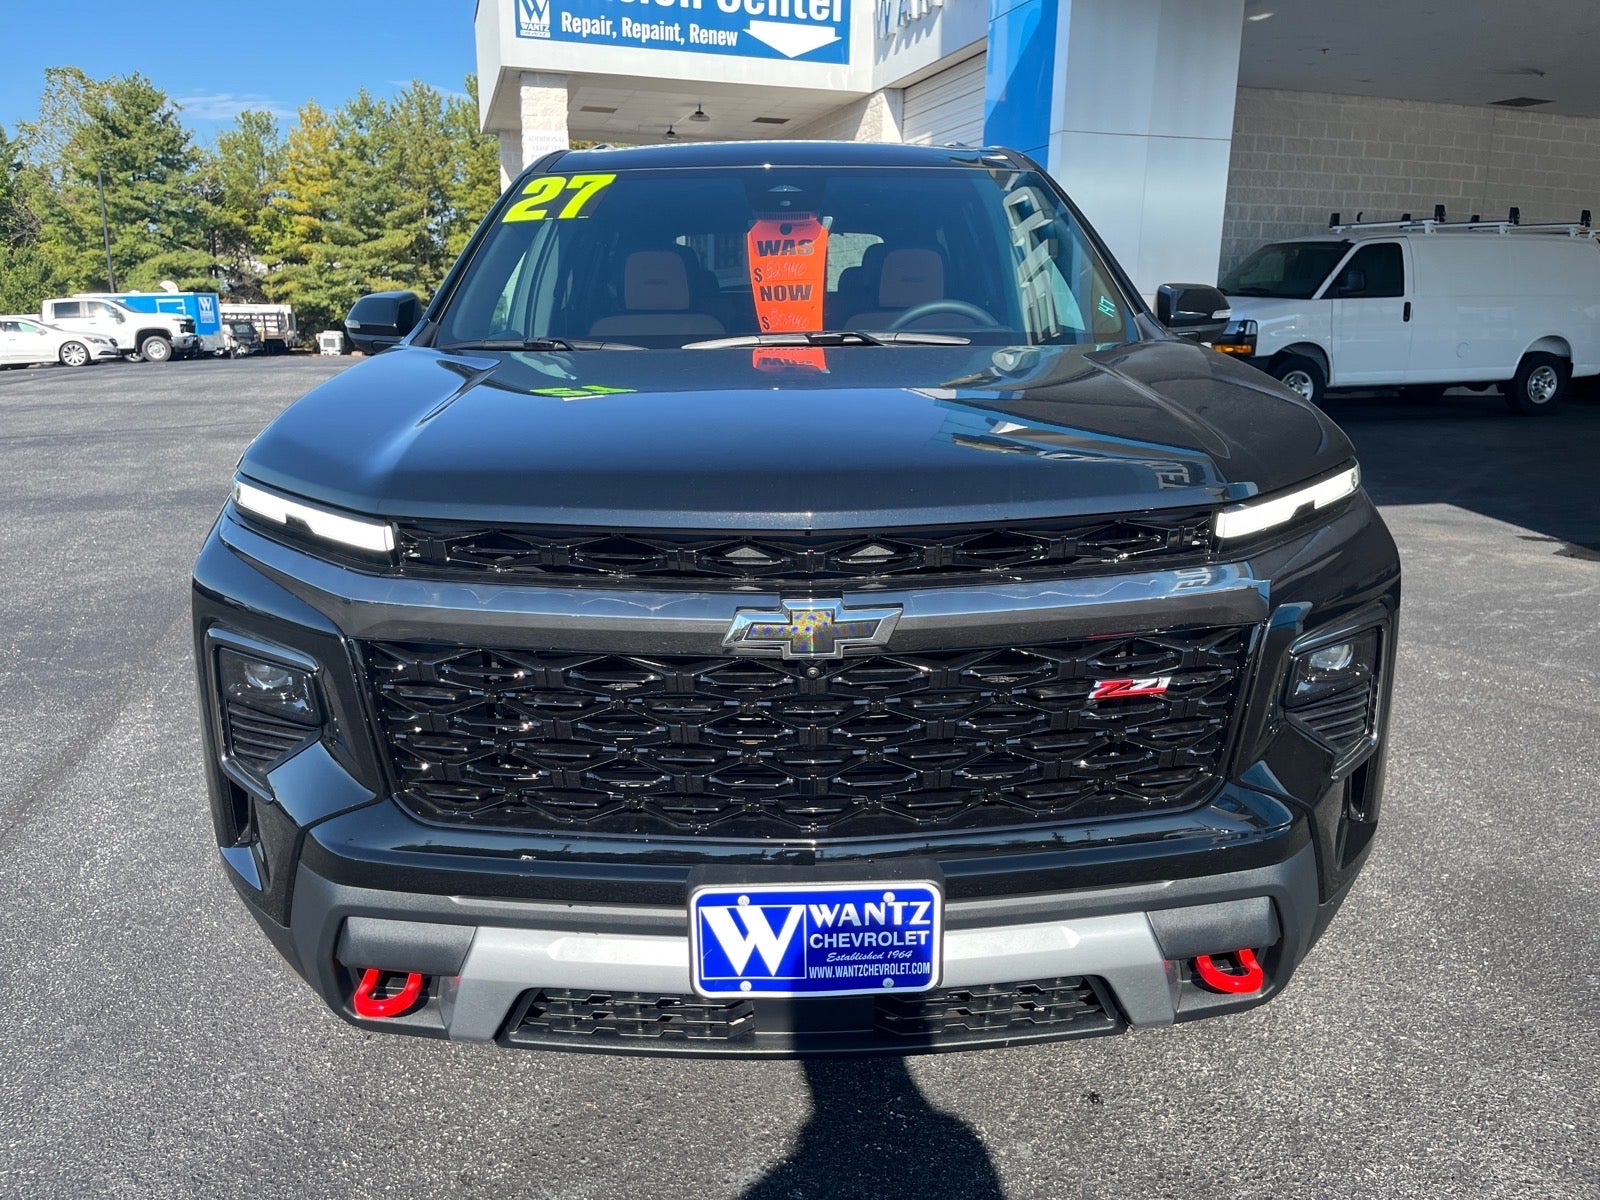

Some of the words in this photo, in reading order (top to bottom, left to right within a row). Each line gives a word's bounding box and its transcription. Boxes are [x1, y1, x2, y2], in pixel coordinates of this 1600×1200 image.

[520, 22, 550, 32] WANTZ
[561, 11, 617, 39] Repair,
[621, 16, 685, 46] Repaint,
[689, 23, 738, 47] Renew
[502, 174, 617, 222] 27
[757, 239, 814, 257] WAS
[759, 284, 813, 302] NOW
[1087, 676, 1172, 700] Z71
[808, 901, 931, 928] WANTZ
[809, 930, 930, 949] CHEVROLET
[826, 951, 885, 963] Established
[887, 949, 913, 960] 1964
[809, 962, 931, 979] WWW.WANTZCHEVROLET.COM
